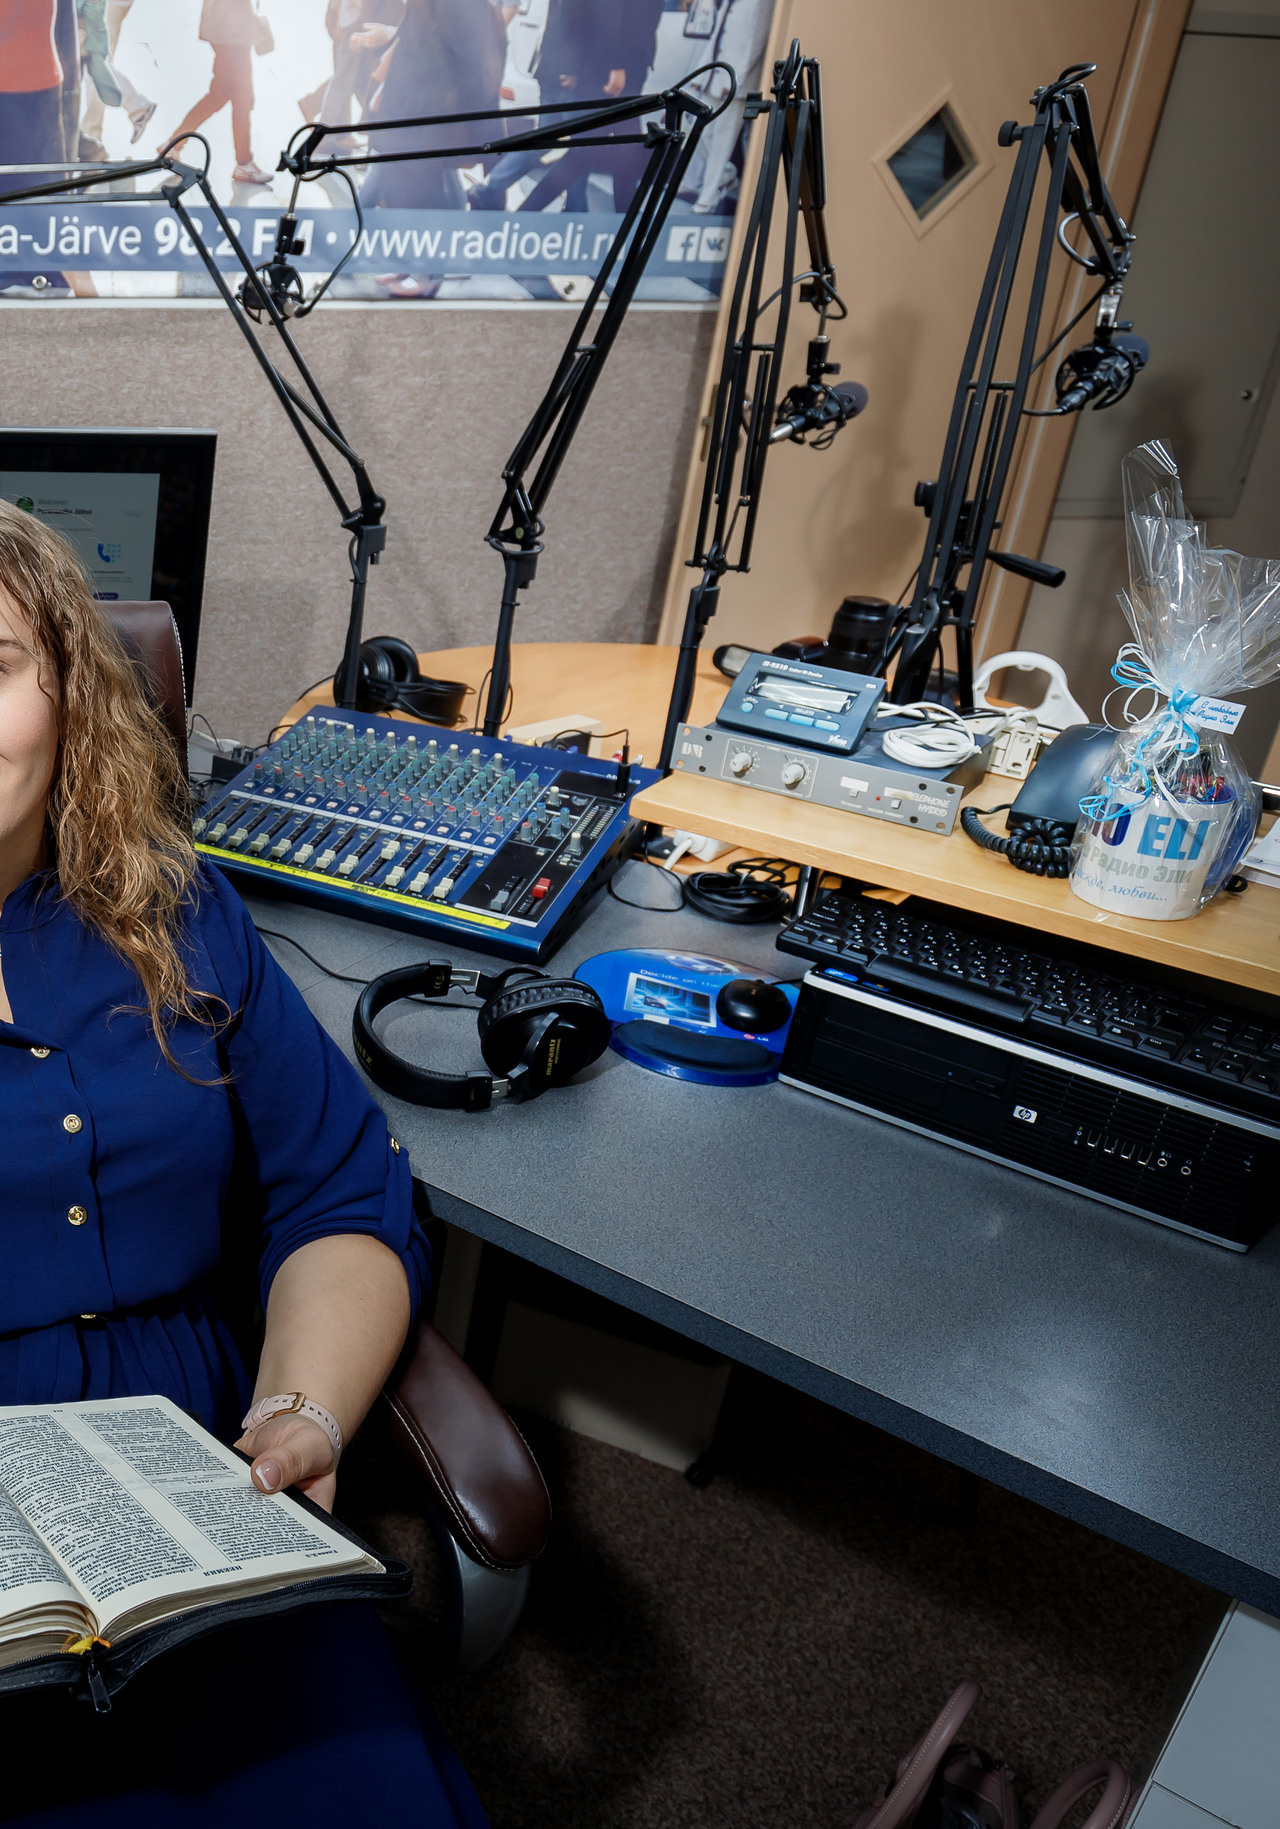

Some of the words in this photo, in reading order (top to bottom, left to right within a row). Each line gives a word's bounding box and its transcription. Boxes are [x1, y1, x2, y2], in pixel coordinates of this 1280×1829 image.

[918, 803, 948, 818] HYBRID
[1136, 813, 1211, 861] ELI
[1090, 846, 1149, 881] Радио
[640, 969, 679, 981] Decide
[545, 1038, 557, 1077] marantz
